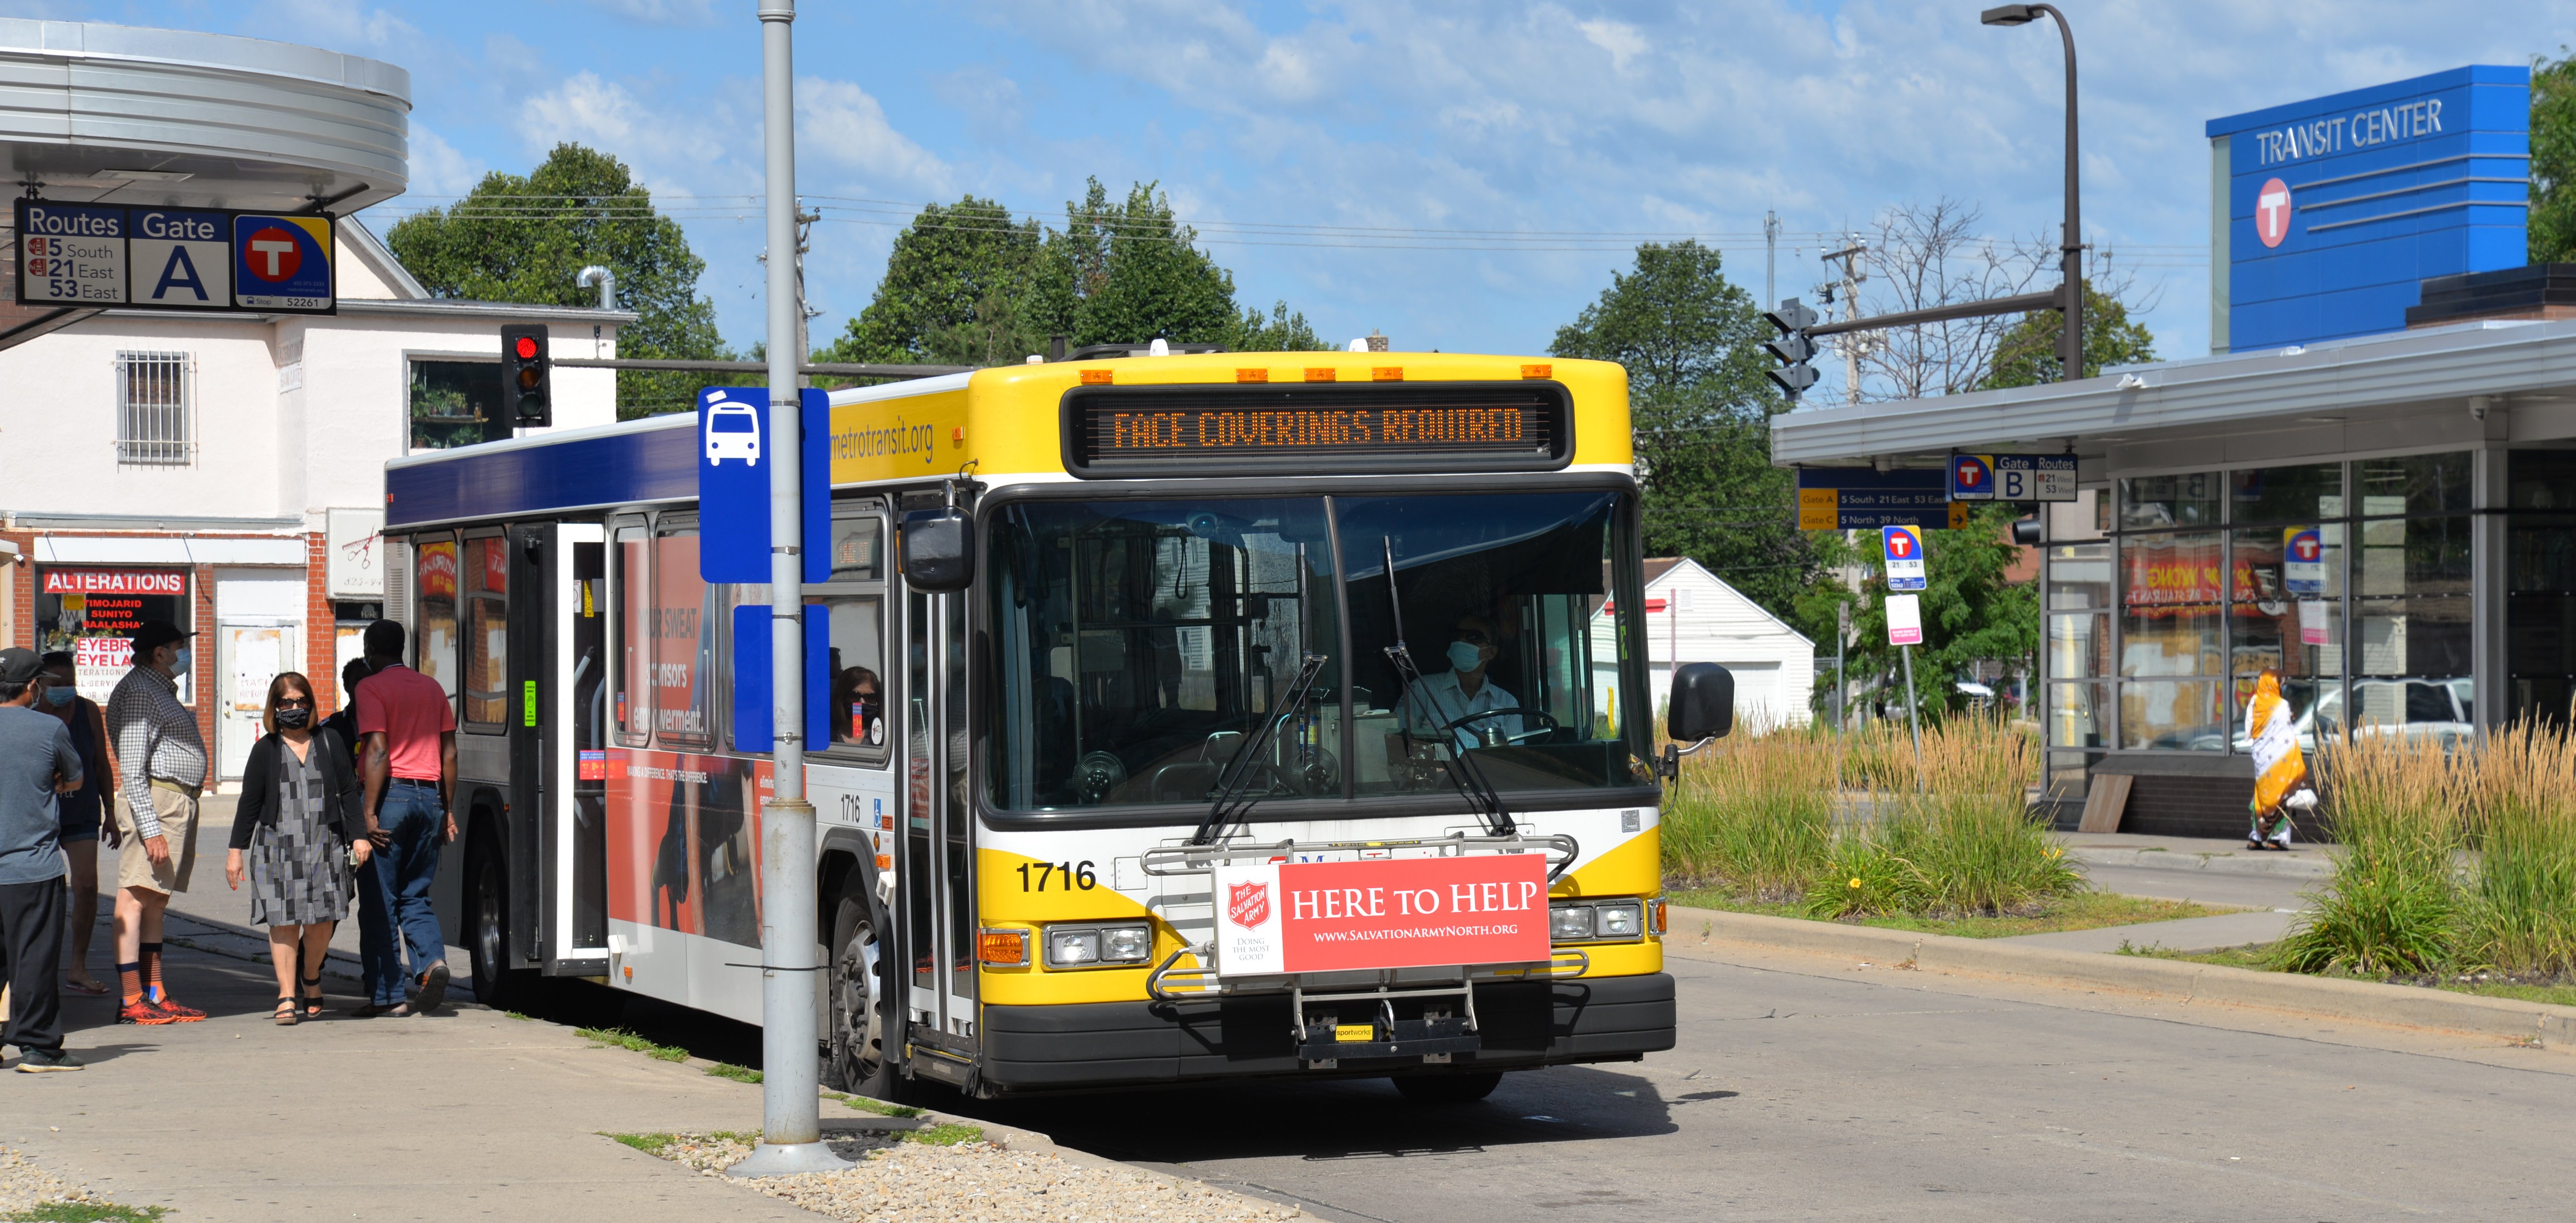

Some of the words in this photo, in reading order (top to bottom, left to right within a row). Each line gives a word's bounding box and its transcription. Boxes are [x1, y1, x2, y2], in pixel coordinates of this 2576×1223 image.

[2256, 117, 2346, 165] TRANSIT
[2351, 98, 2442, 148] CENTER
[29, 208, 119, 236] Routes
[2261, 192, 2285, 238] T
[143, 213, 215, 240] Gate
[49, 239, 63, 256] 5
[67, 244, 113, 258] South
[252, 240, 293, 275] T
[49, 259, 74, 277] 21
[79, 264, 114, 279] East
[152, 245, 209, 301] A
[49, 279, 78, 297] 53
[83, 285, 118, 299] East
[256, 298, 272, 306] Stop
[287, 298, 318, 307] 52261
[1115, 413, 1186, 448] FACE
[1199, 410, 1371, 447] COVERINGS
[1383, 408, 1522, 443] REQUIRED
[830, 415, 933, 464] metrotransit.org
[2000, 457, 2029, 469] Gate
[2039, 457, 2074, 469] Routes
[1961, 467, 1978, 484] T
[2006, 472, 2023, 497] B
[2046, 474, 2055, 483] 21
[1803, 495, 1823, 503] Gate
[1826, 495, 1833, 503] A
[1842, 495, 1847, 503] 5
[1850, 494, 1874, 504] South
[1880, 495, 1889, 504] 21
[1892, 495, 1909, 504] East
[1915, 495, 1926, 504] 53
[1929, 495, 1946, 504] East
[2046, 485, 2056, 494] 53
[1803, 516, 1824, 524] Gate
[1826, 516, 1833, 524] C
[1842, 515, 1847, 524] 5
[1850, 515, 1875, 525] North
[1880, 515, 1891, 524] 39
[1894, 515, 1919, 524] North
[1891, 538, 1908, 555] T
[48, 573, 180, 591] ALTERATIONS
[82, 599, 142, 608] TIMOJARID
[665, 608, 697, 639] SWEAT
[78, 639, 134, 652] EYEBR
[627, 766, 640, 777] MAKING
[641, 767, 644, 777] A
[644, 767, 666, 779] DIFFERENCE.
[666, 769, 678, 780] THAT'S
[685, 771, 707, 784] DIFFERENCE.
[841, 793, 860, 823] 1716
[1016, 860, 1096, 892] 1716
[1231, 887, 1265, 918] SALVATION
[1236, 885, 1251, 901] THE
[1291, 887, 1385, 919] HERE
[1393, 889, 1439, 915] TO
[1449, 882, 1537, 913] HELP
[1244, 901, 1264, 924] ARMY
